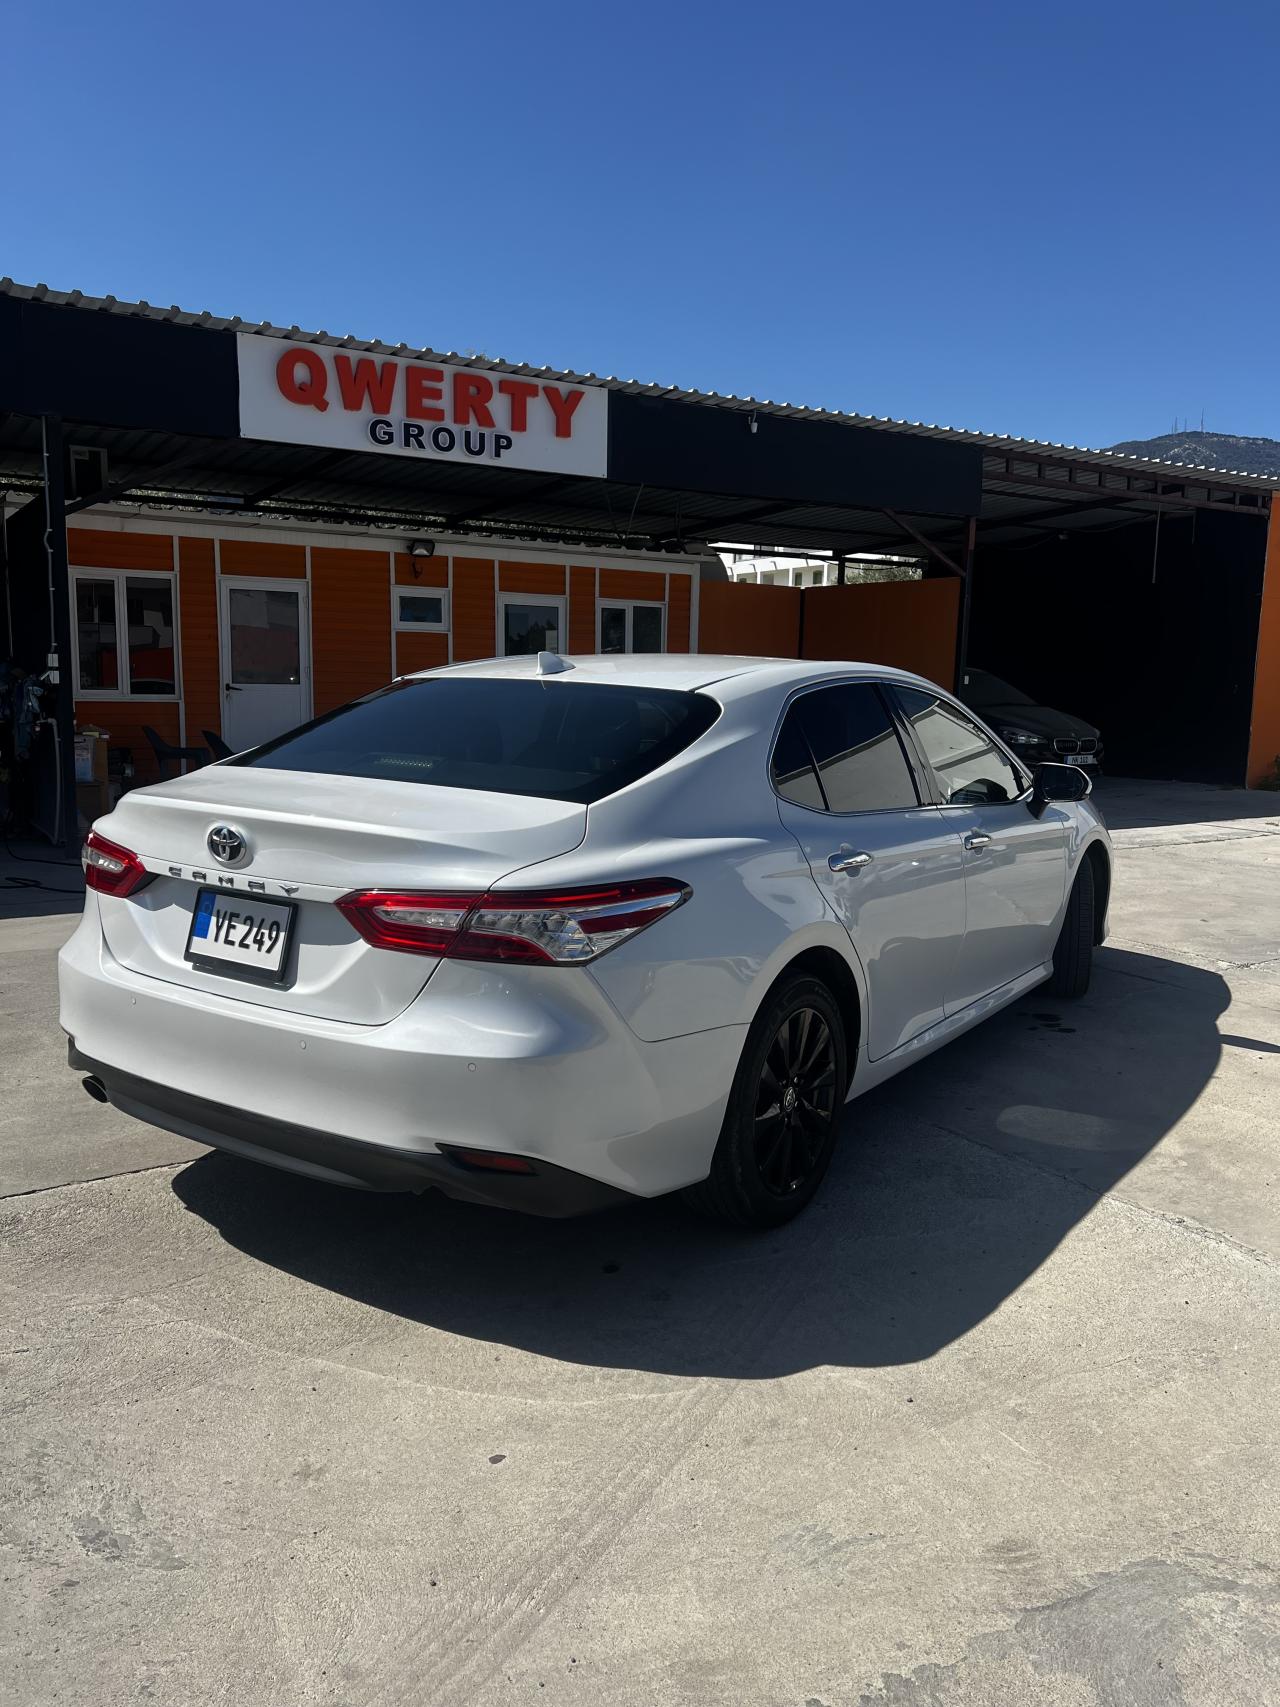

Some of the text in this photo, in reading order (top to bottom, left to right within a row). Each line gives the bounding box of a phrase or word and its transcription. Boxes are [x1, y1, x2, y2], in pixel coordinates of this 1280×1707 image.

[276, 347, 585, 439] QWERTY
[369, 418, 513, 458] GROUP
[214, 908, 281, 954] YE249
